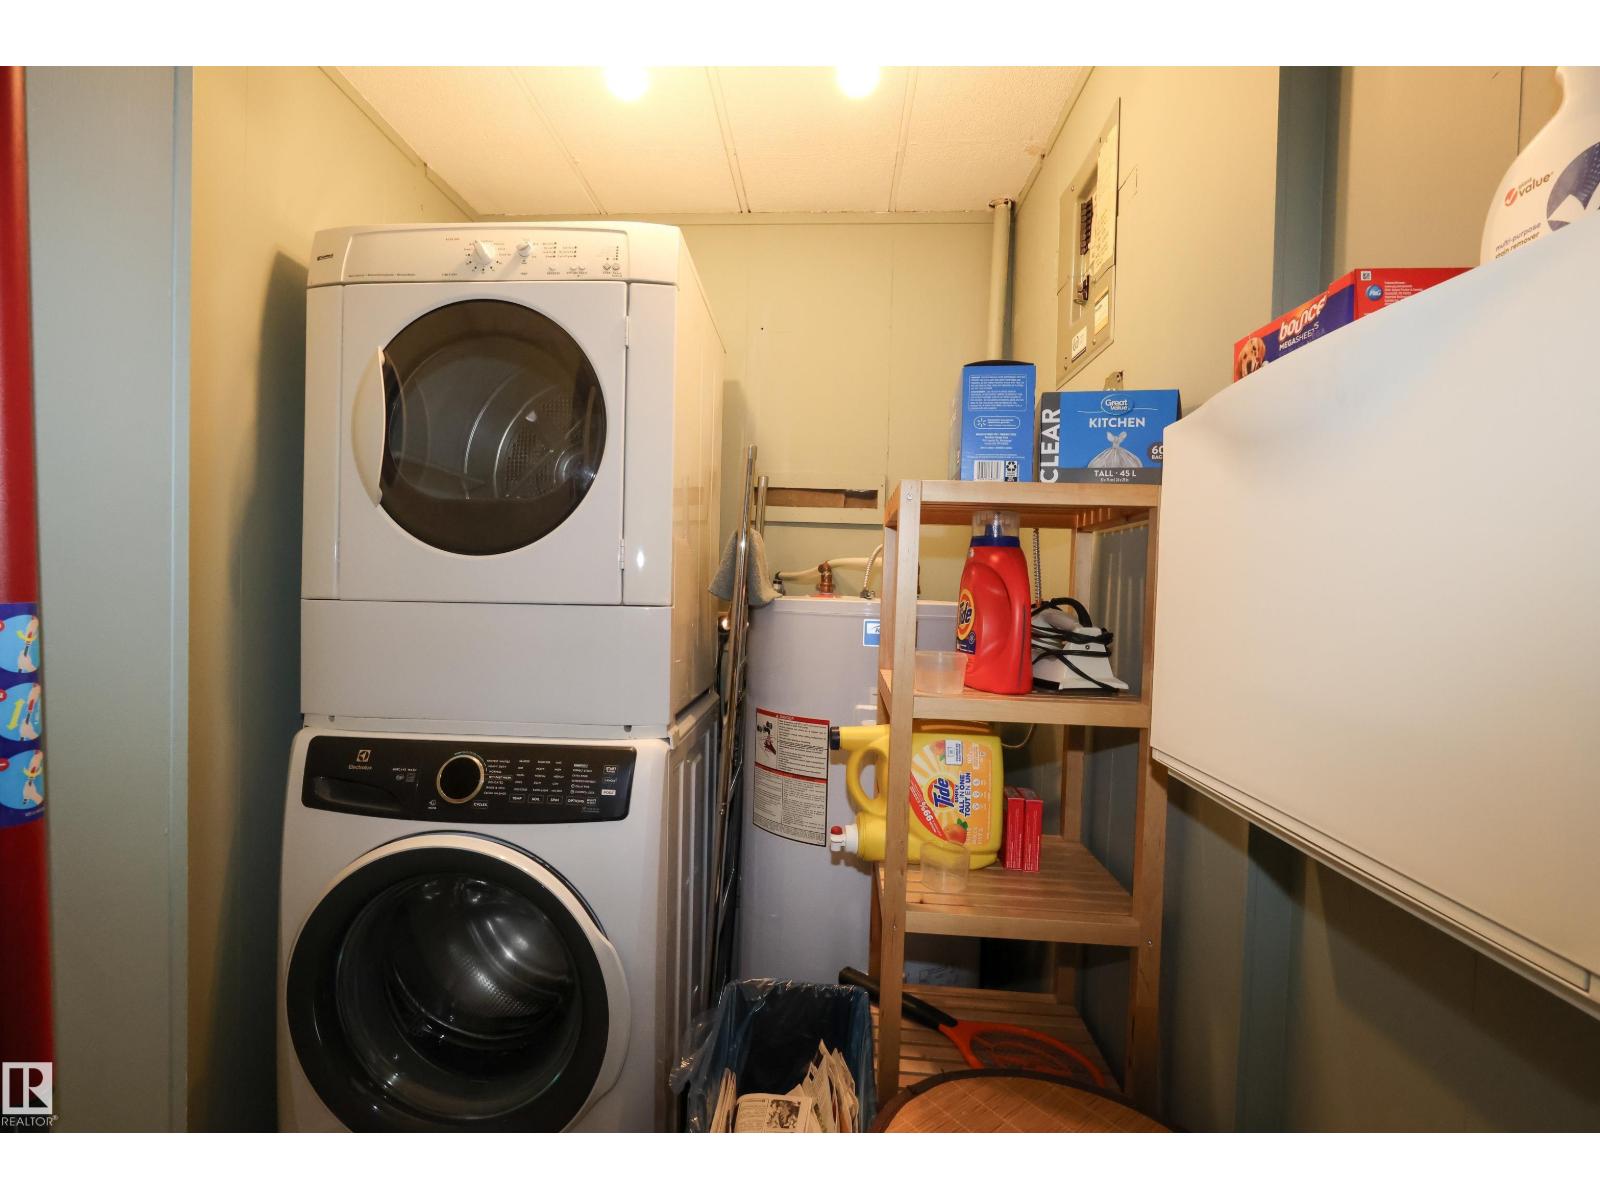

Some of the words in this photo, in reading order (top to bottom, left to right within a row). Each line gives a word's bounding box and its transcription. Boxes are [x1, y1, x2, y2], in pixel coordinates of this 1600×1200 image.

[1519, 173, 1551, 197] value
[1279, 294, 1328, 341] bounce
[1279, 321, 1319, 351] MEGASHEETS
[1089, 417, 1146, 428] KITCHEN
[1040, 408, 1060, 483] CLEAR
[1094, 469, 1114, 477] TALL
[1119, 469, 1130, 477] 45
[1132, 469, 1137, 477] L
[965, 772, 971, 784] UN
[933, 777, 954, 808] Tide
[965, 785, 971, 796] EN
[919, 801, 934, 822] 99%
